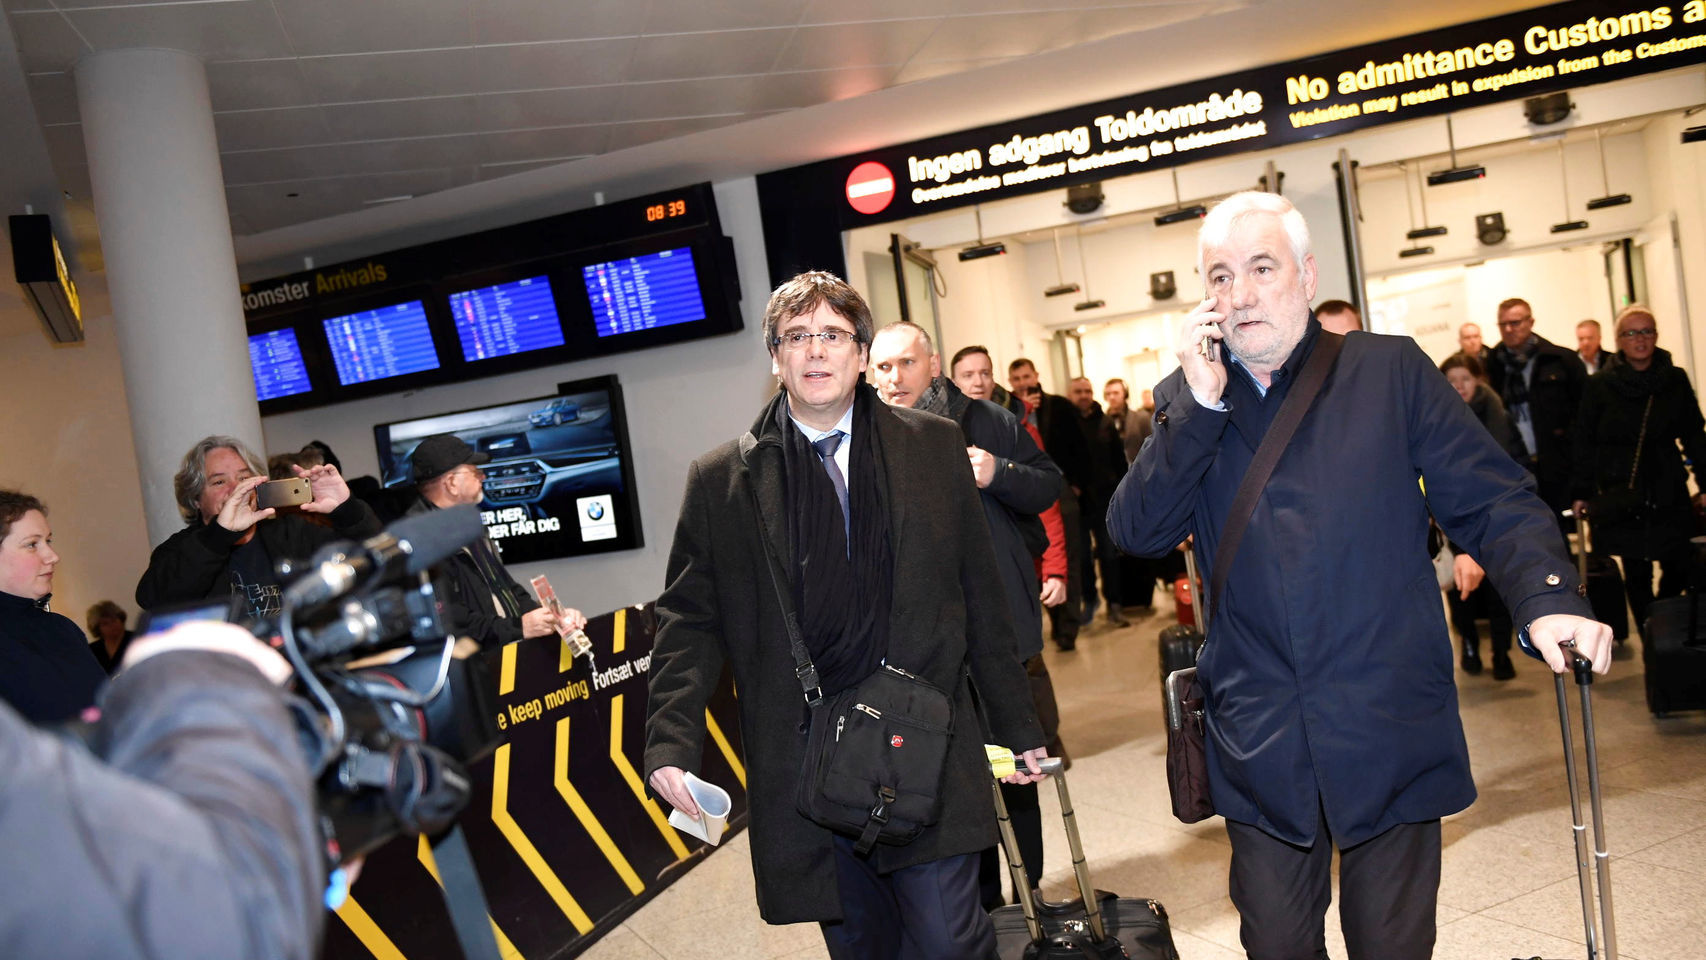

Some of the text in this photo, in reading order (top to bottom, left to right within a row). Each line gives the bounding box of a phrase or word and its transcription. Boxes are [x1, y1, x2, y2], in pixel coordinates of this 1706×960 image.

[1286, 75, 1330, 105] No
[1337, 38, 1516, 95] admittance
[1523, 7, 1673, 55] Customs
[1289, 103, 1361, 128] Violation
[1362, 95, 1398, 113] may
[1400, 83, 1450, 106] result
[1451, 80, 1470, 96] in
[1472, 64, 1555, 91] expulsion
[1557, 55, 1600, 75] from
[1602, 48, 1634, 66] the
[908, 88, 1263, 182] Ingen adgang Toldområde
[315, 262, 388, 294] Arrivals
[537, 517, 560, 533] DIG
[508, 698, 543, 725] keep
[544, 680, 589, 710] moving
[592, 660, 633, 690] Fortsæt
